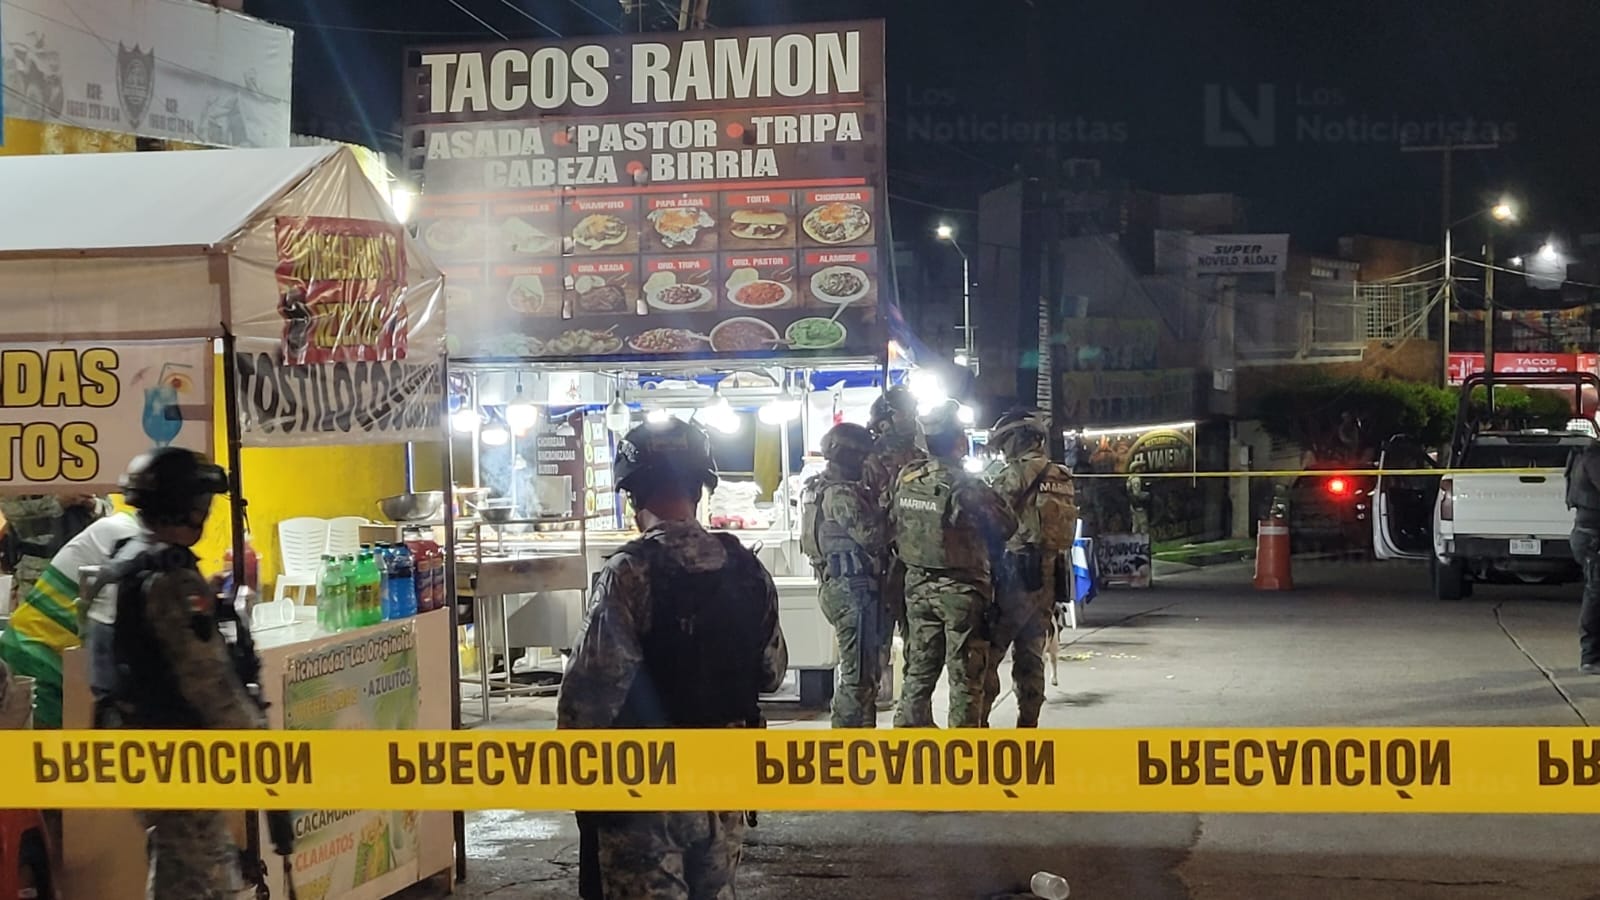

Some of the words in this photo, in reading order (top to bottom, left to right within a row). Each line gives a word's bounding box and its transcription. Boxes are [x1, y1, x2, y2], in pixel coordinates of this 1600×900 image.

[421, 44, 610, 113] TACOS
[632, 31, 860, 104] RAMON
[427, 126, 545, 160] ASADA
[577, 119, 717, 153] PASTOR
[751, 112, 862, 145] TRIPA
[483, 156, 618, 189] CABEZA
[650, 148, 779, 181] BIRRIA
[578, 200, 625, 210] VAMPIRO
[655, 199, 675, 208] PAPA
[746, 195, 771, 204] TORTA
[1214, 245, 1262, 254] SUPER
[752, 257, 784, 266] PASTOR
[1516, 358, 1557, 366] TACOS
[899, 497, 937, 511] MARINA
[368, 668, 412, 698] AZULITOS
[295, 832, 354, 873] CLAMATOS
